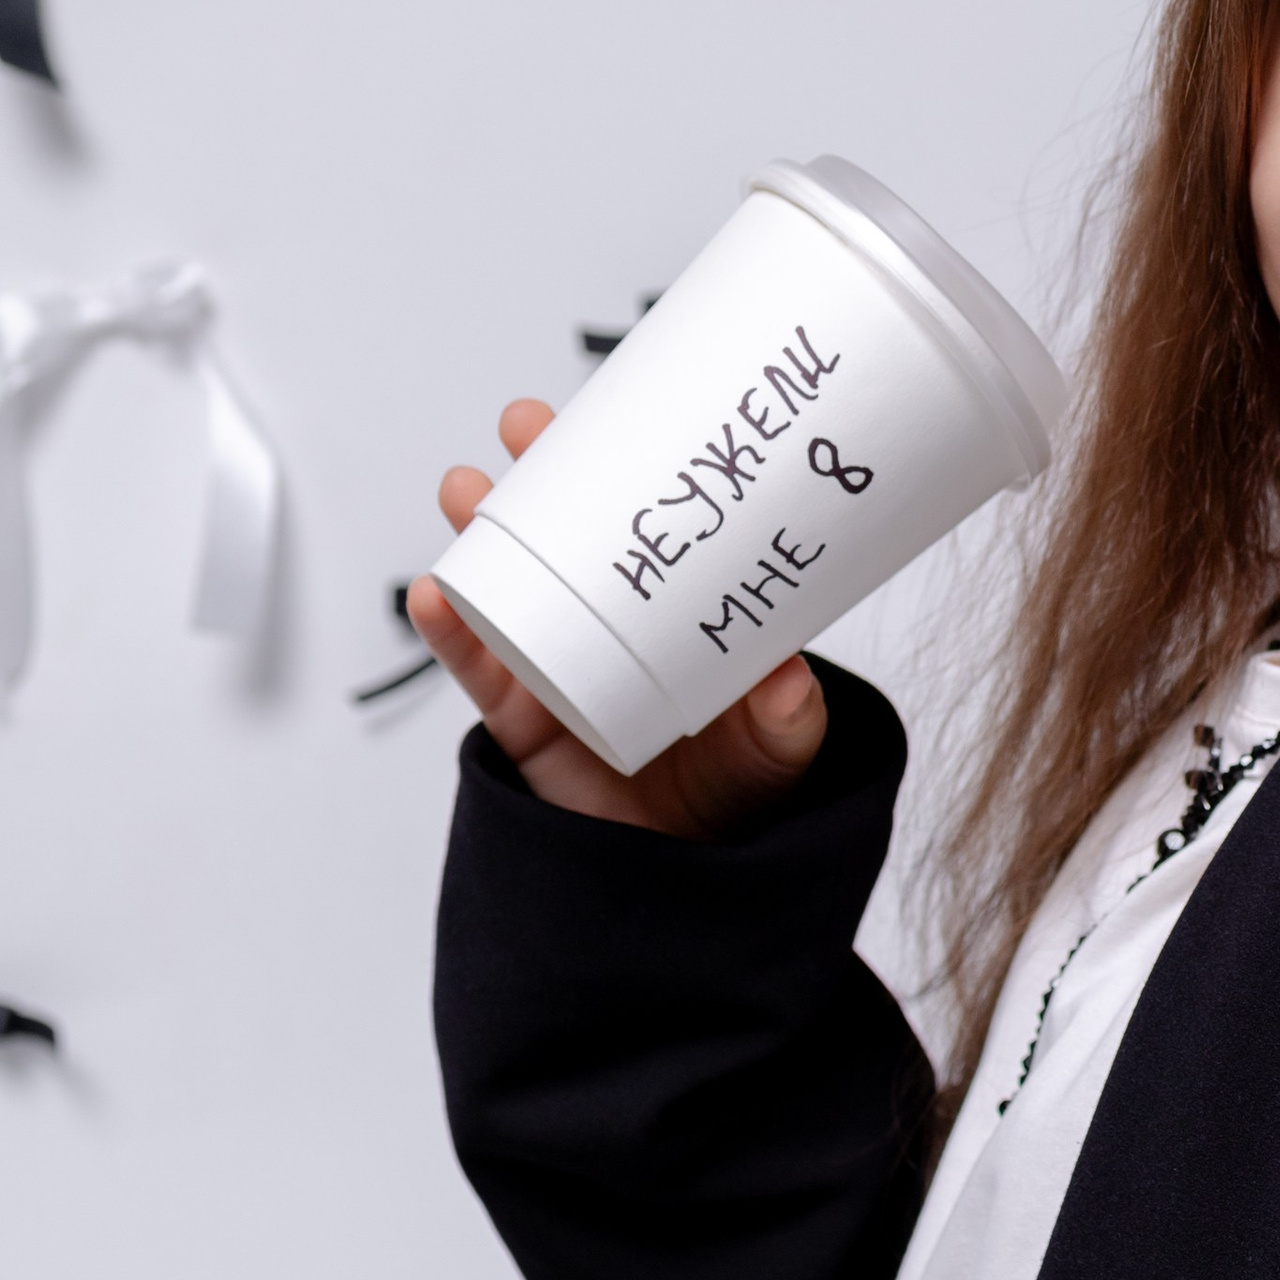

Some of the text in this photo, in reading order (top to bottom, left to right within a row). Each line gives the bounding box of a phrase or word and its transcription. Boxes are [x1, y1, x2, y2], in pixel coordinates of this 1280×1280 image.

[613, 326, 841, 600] НЕУЖЕЛИ
[699, 438, 875, 655] МНЕ 8
